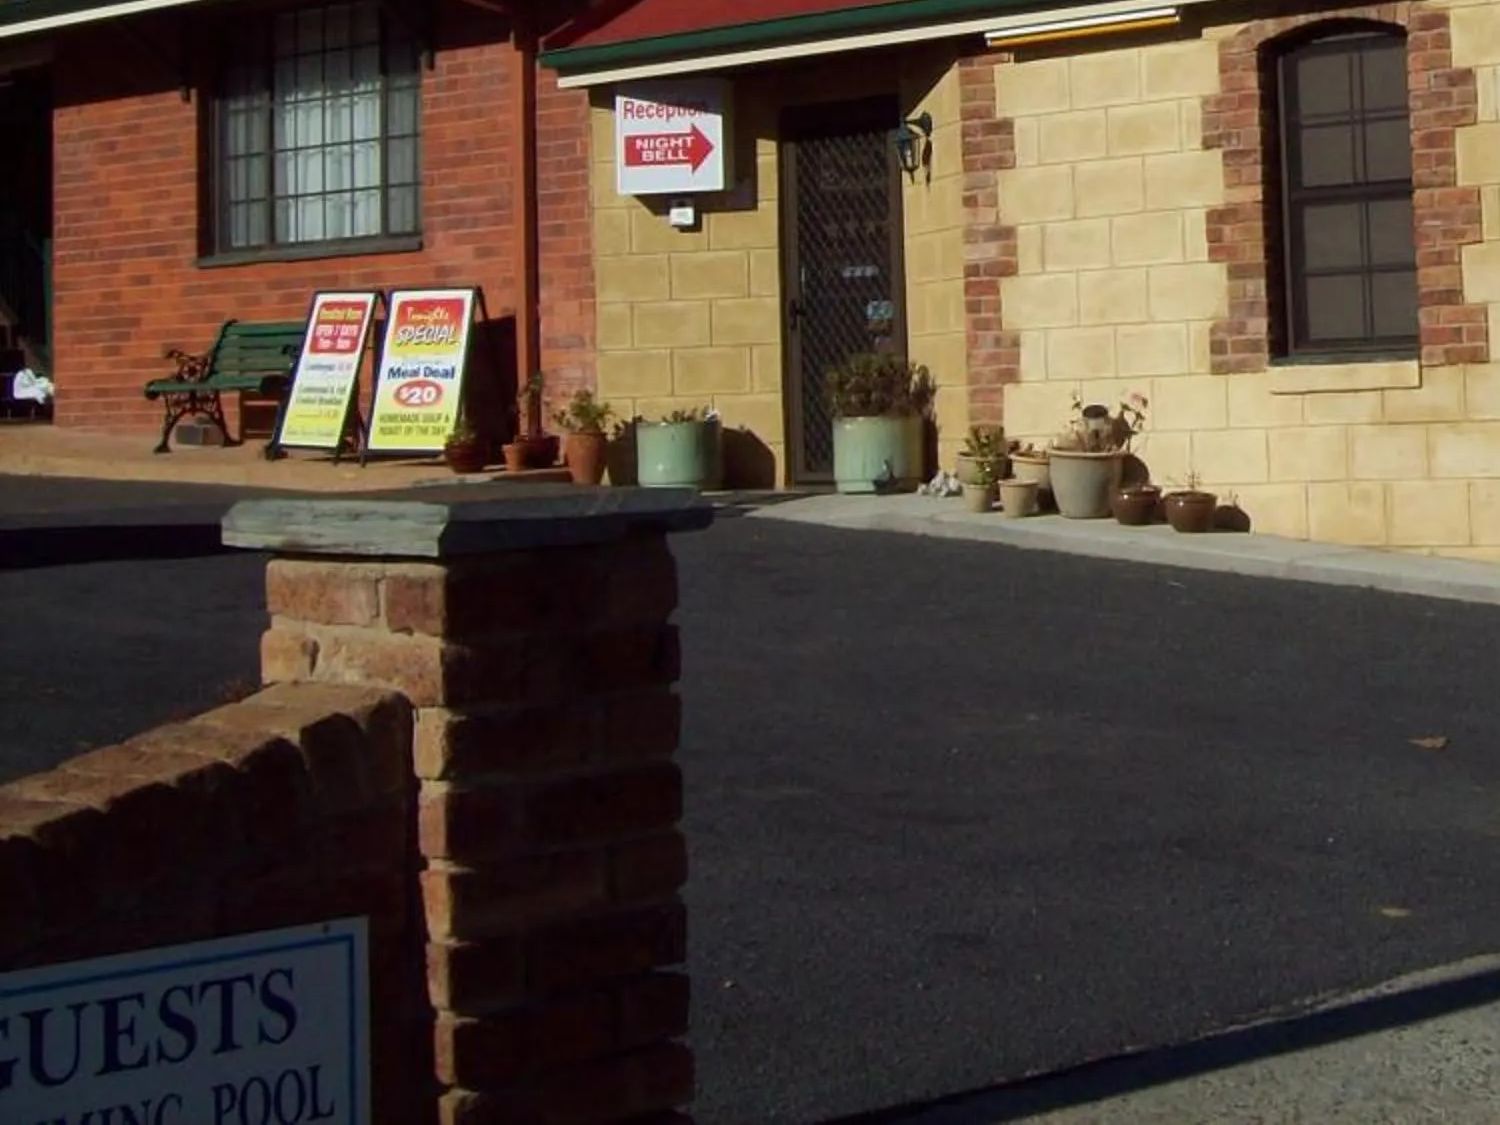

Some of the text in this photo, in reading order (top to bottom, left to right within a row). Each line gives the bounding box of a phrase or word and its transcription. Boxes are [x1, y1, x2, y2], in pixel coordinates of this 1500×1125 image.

[635, 137, 695, 150] NIGHT
[641, 150, 689, 162] BELL
[398, 324, 459, 347] SPECIAL
[388, 366, 455, 379] Meal Deal
[400, 386, 437, 404] $20
[212, 1063, 335, 1125] POOL
